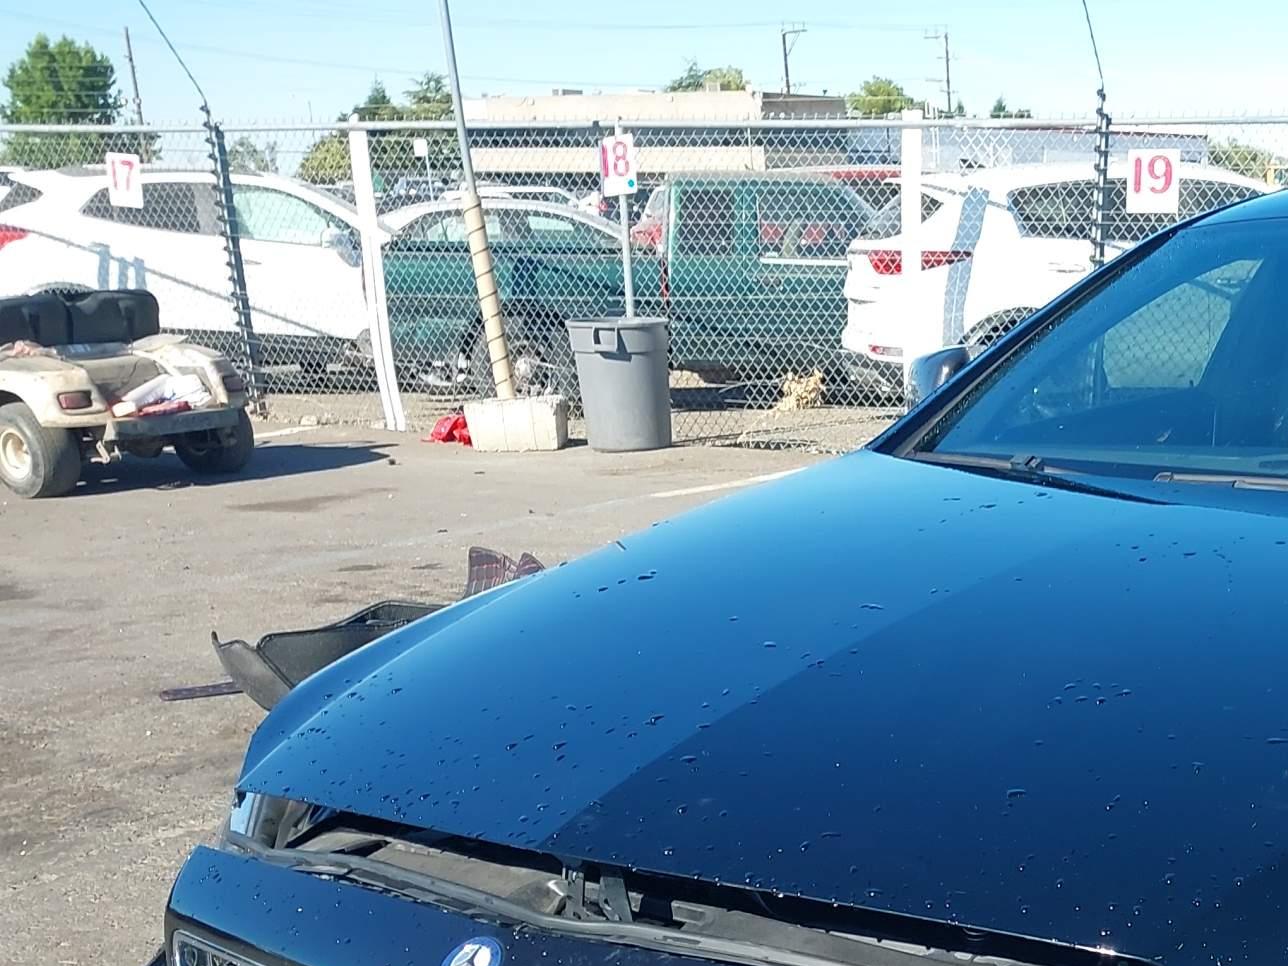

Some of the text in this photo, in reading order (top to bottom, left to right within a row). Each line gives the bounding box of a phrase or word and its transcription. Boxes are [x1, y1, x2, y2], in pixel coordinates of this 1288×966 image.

[111, 159, 135, 192] 17
[601, 140, 630, 178] 18
[1133, 154, 1173, 194] 19
